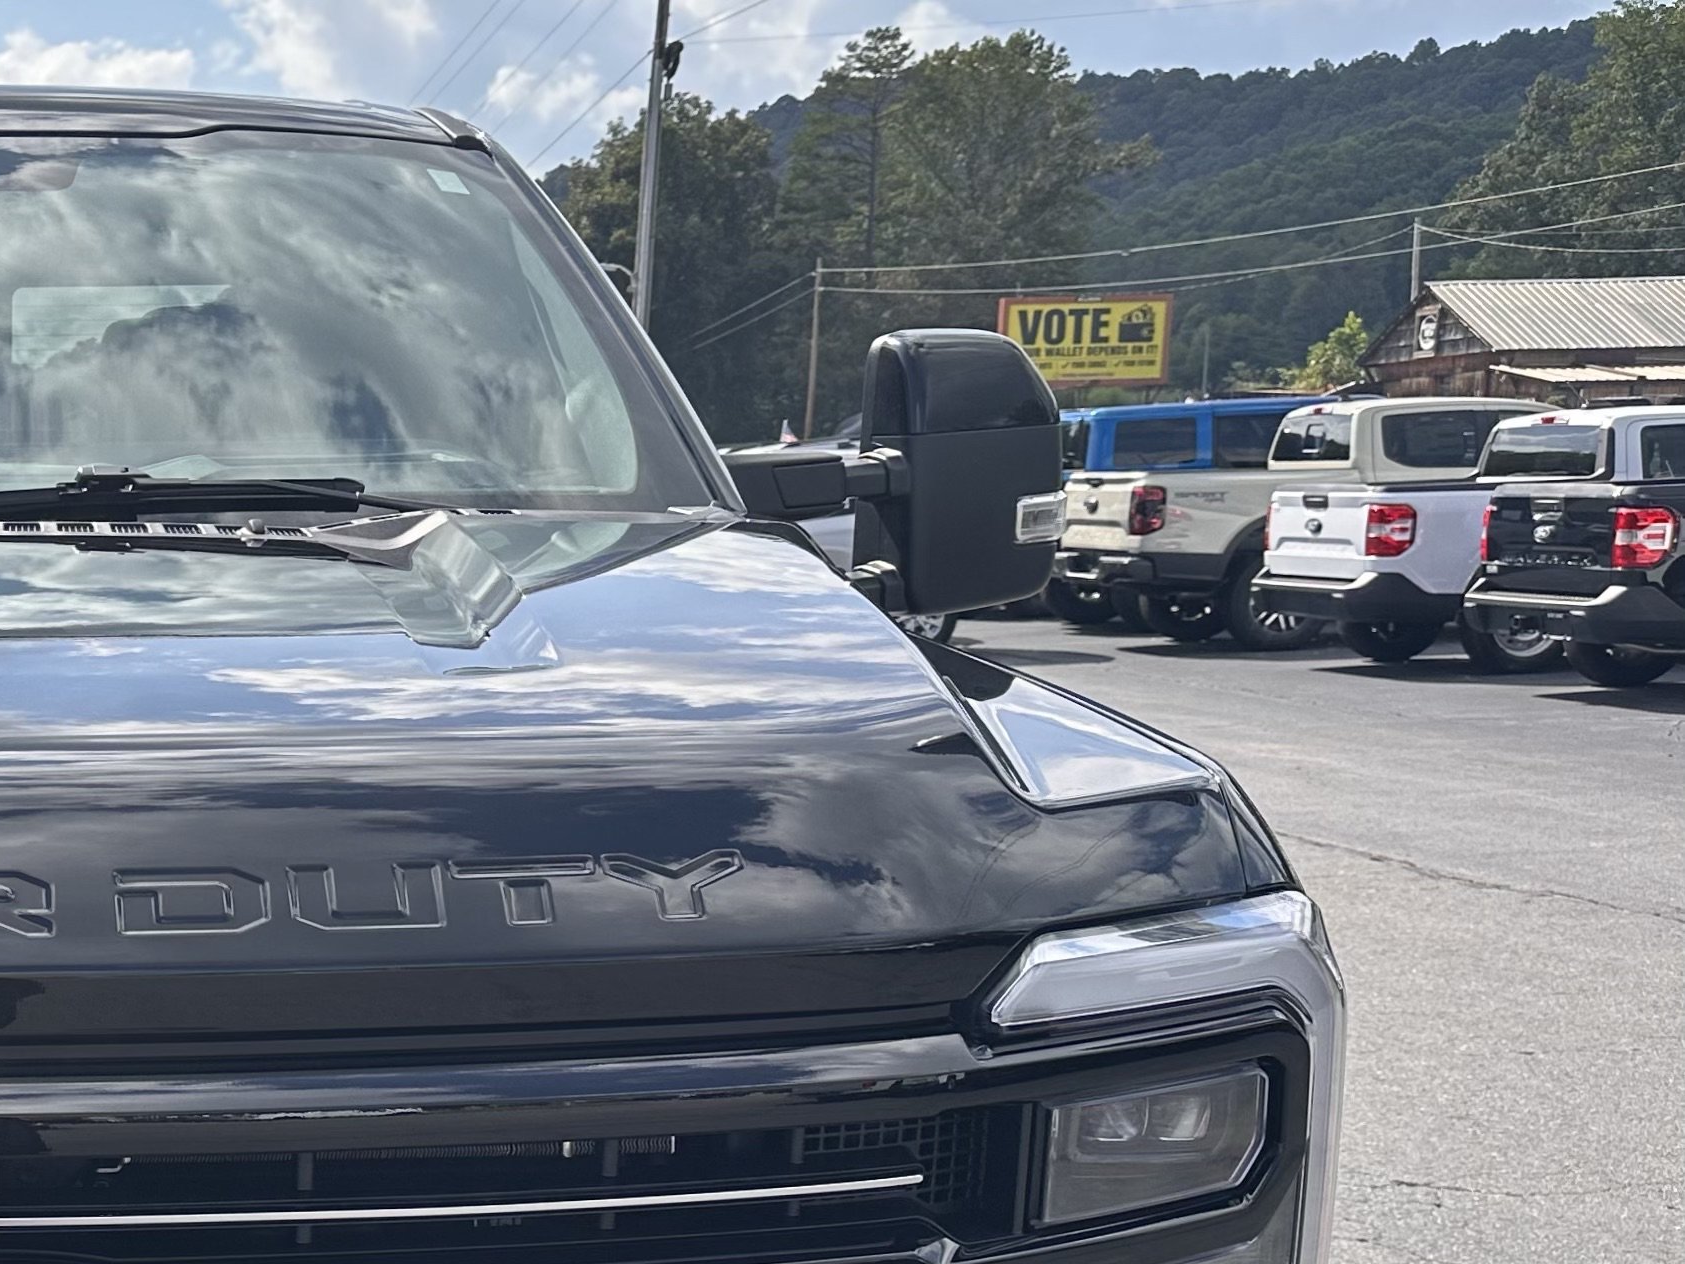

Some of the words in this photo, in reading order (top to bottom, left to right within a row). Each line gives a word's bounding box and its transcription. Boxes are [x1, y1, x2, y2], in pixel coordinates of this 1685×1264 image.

[1017, 308, 1111, 345] VOTE
[1045, 346, 1084, 357] WALLET
[1086, 345, 1128, 356] DEPENDS
[1131, 344, 1144, 354] ON
[112, 848, 745, 936] DUTY
